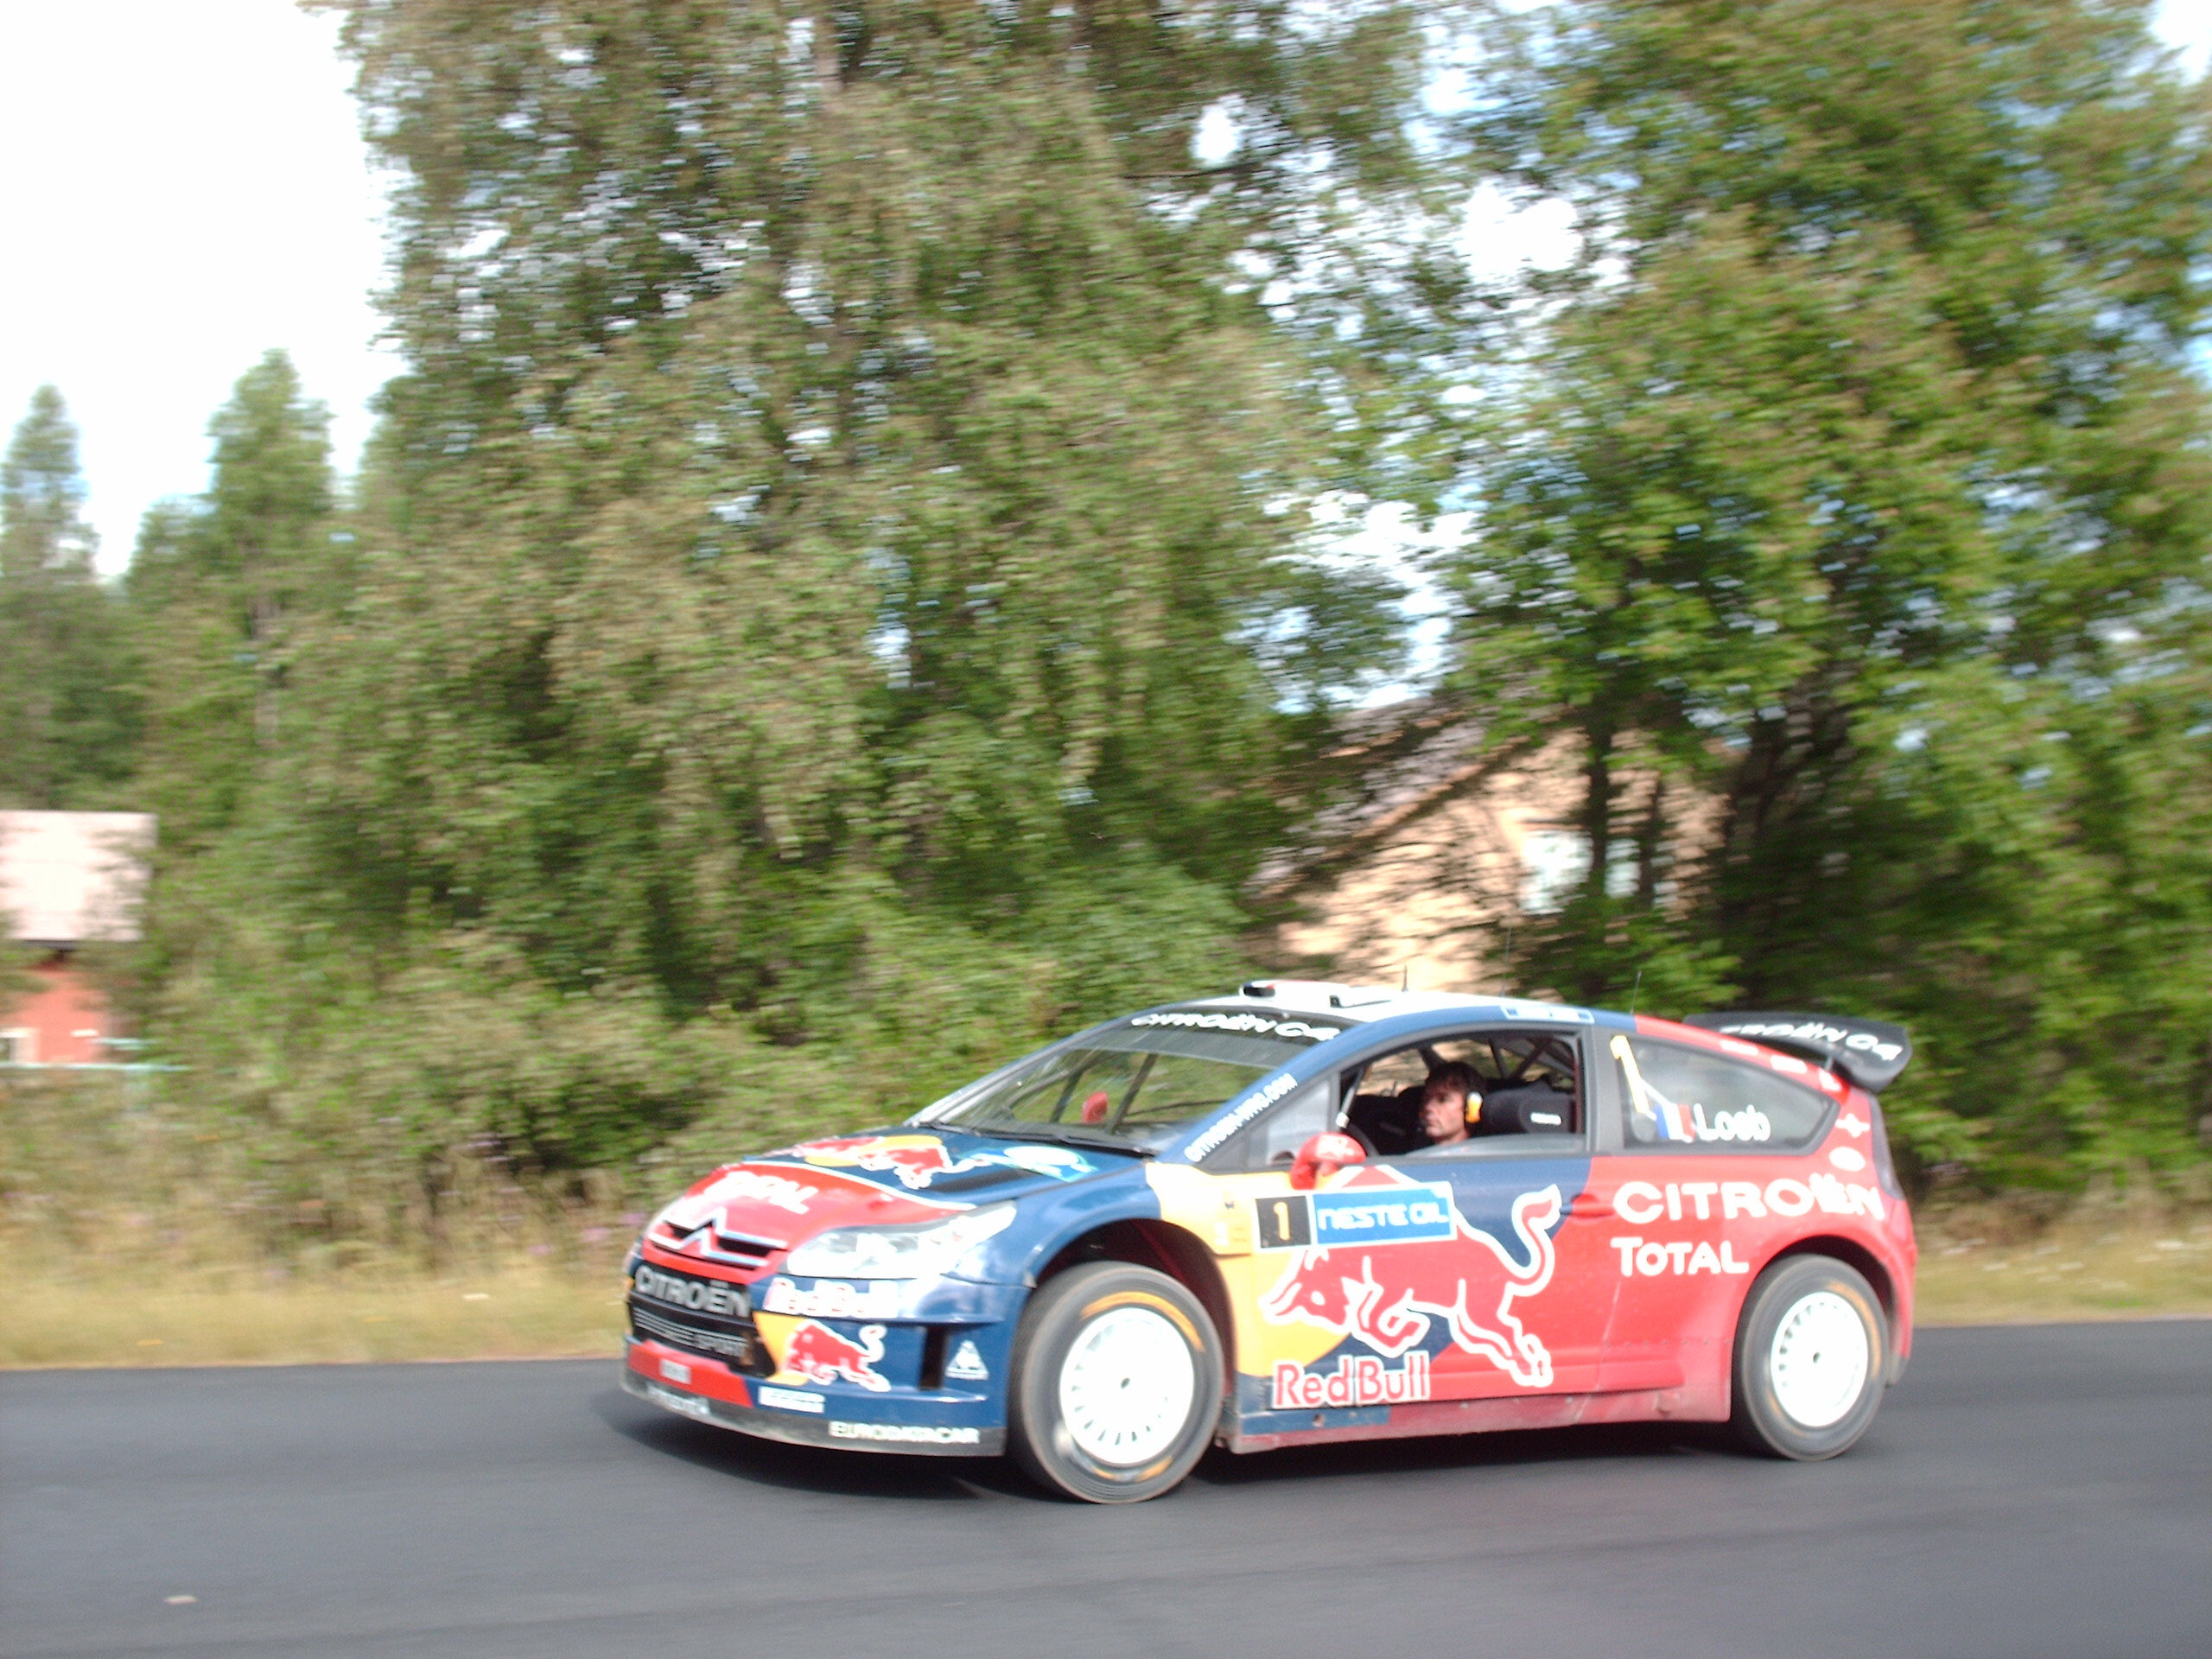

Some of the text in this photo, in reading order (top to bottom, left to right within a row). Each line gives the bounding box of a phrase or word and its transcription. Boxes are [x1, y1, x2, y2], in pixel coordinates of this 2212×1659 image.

[1274, 1202, 1291, 1241] 1
[1611, 1236, 1750, 1276] TOTAL
[635, 1265, 751, 1318] CITROËN
[1274, 1352, 1427, 1408] Red Bull
